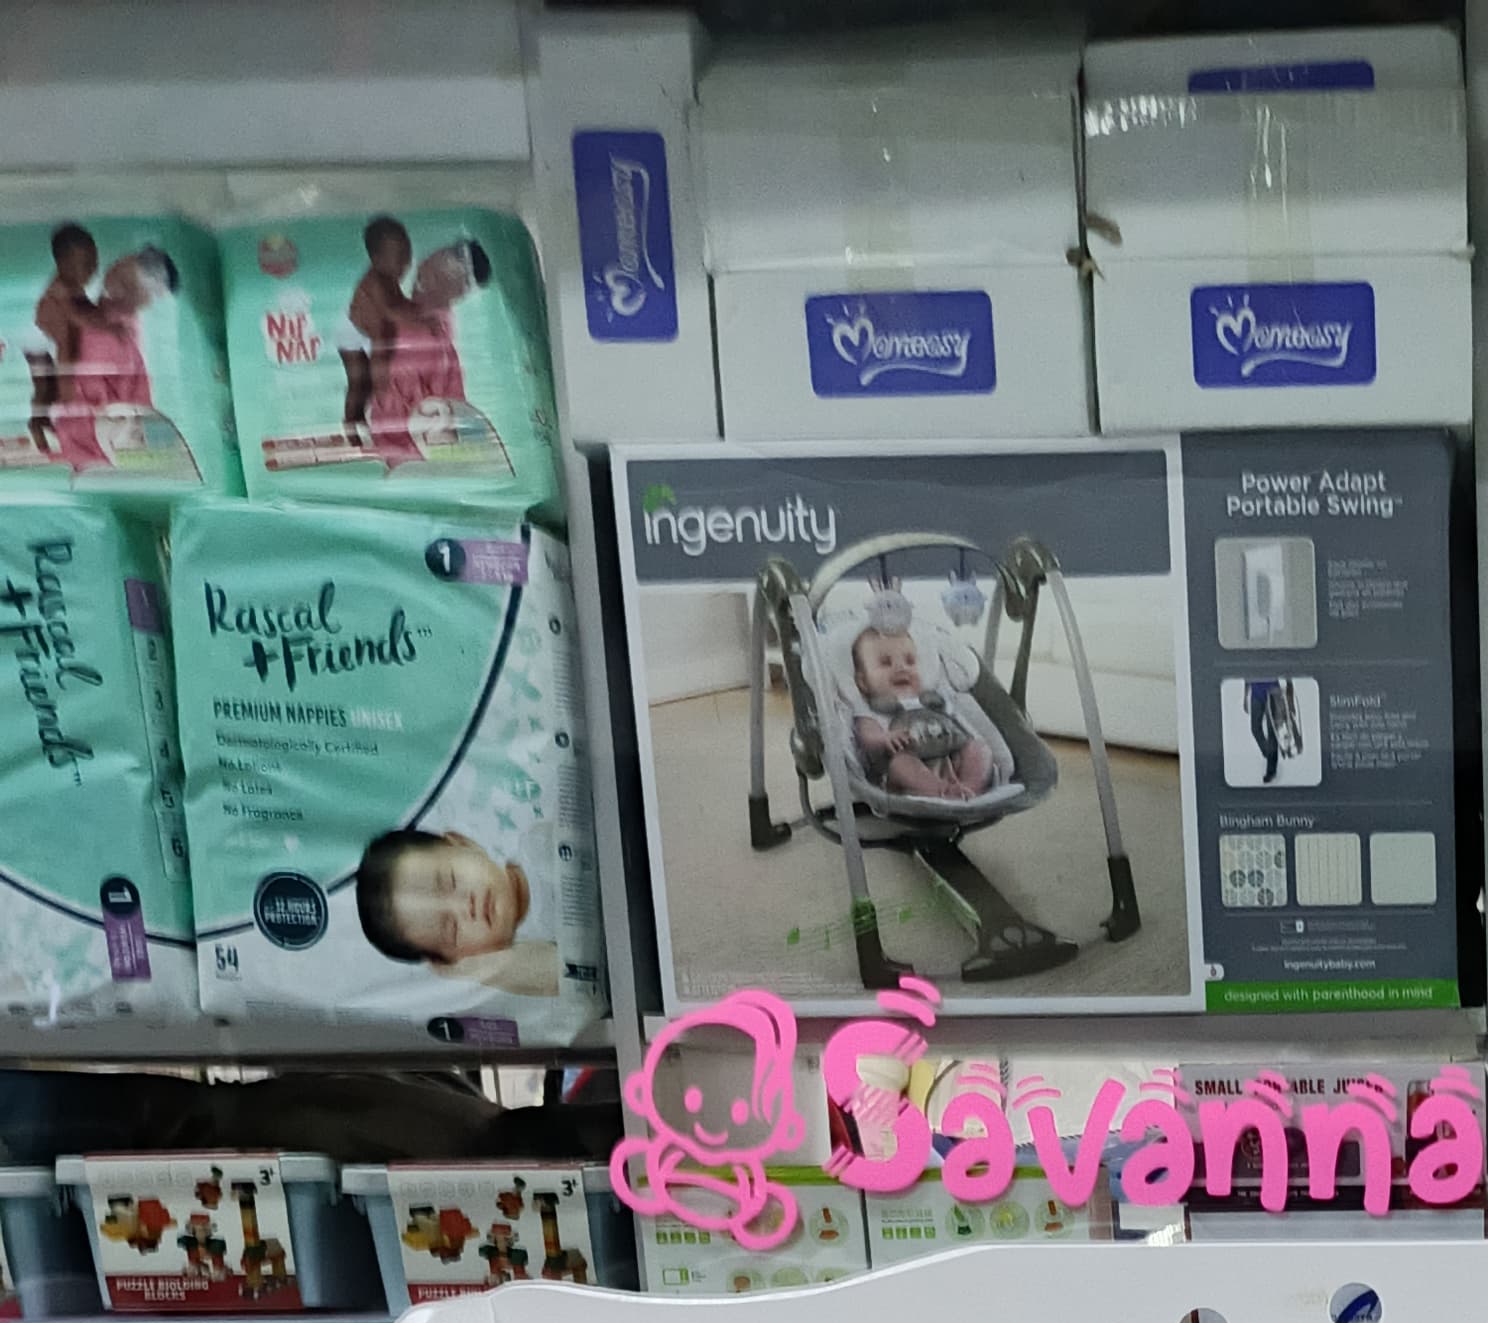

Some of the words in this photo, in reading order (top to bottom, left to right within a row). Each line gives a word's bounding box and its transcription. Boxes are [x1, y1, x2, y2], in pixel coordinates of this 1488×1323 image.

[1241, 471, 1312, 495] Power
[1319, 469, 1387, 496] Adapt
[1226, 494, 1321, 518] Portable
[1327, 493, 1395, 519] Swing
[643, 497, 837, 556] ingenuity
[206, 582, 336, 640] Rascal
[213, 698, 282, 724] PREMIUM
[286, 701, 348, 728] NAPPIES
[1224, 990, 1281, 1003] designed
[1283, 988, 1309, 1002] with
[1312, 986, 1386, 1004] parenthood
[1402, 985, 1434, 1001] mind
[1195, 1079, 1243, 1096] SMALL
[822, 1000, 1486, 1218] Savanna
